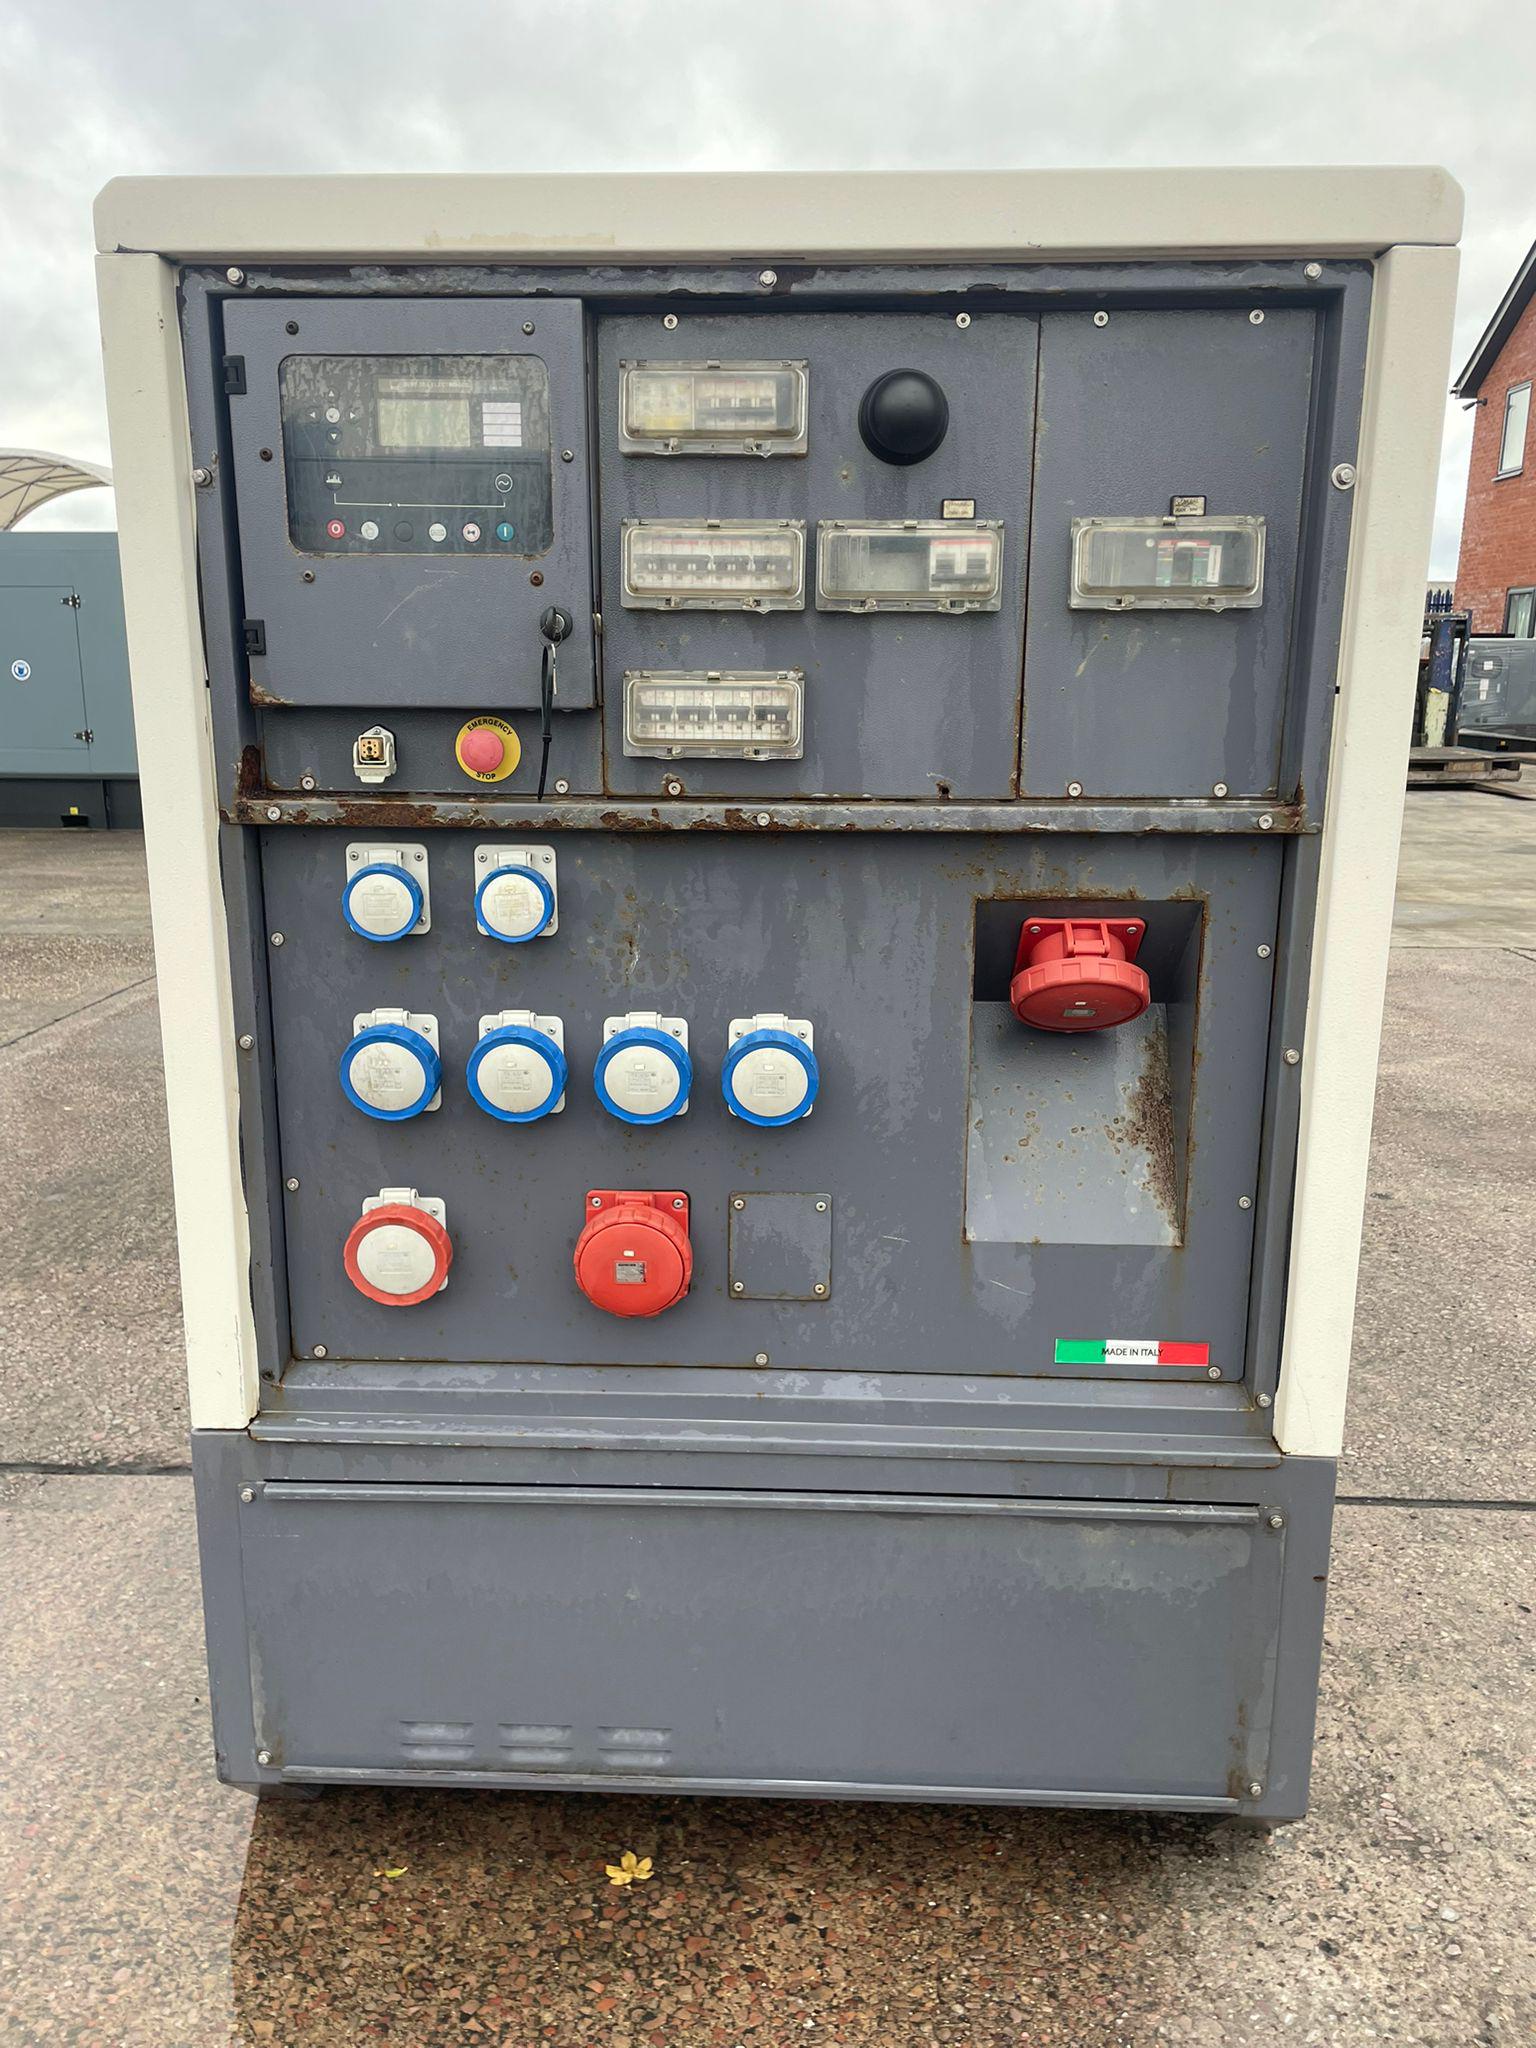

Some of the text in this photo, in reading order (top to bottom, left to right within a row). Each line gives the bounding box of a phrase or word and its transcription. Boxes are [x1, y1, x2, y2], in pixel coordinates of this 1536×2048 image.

[467, 718, 513, 735] EMERGENCY
[476, 772, 496, 780] STOP
[1101, 1348, 1164, 1357] MADE IN ITALY
